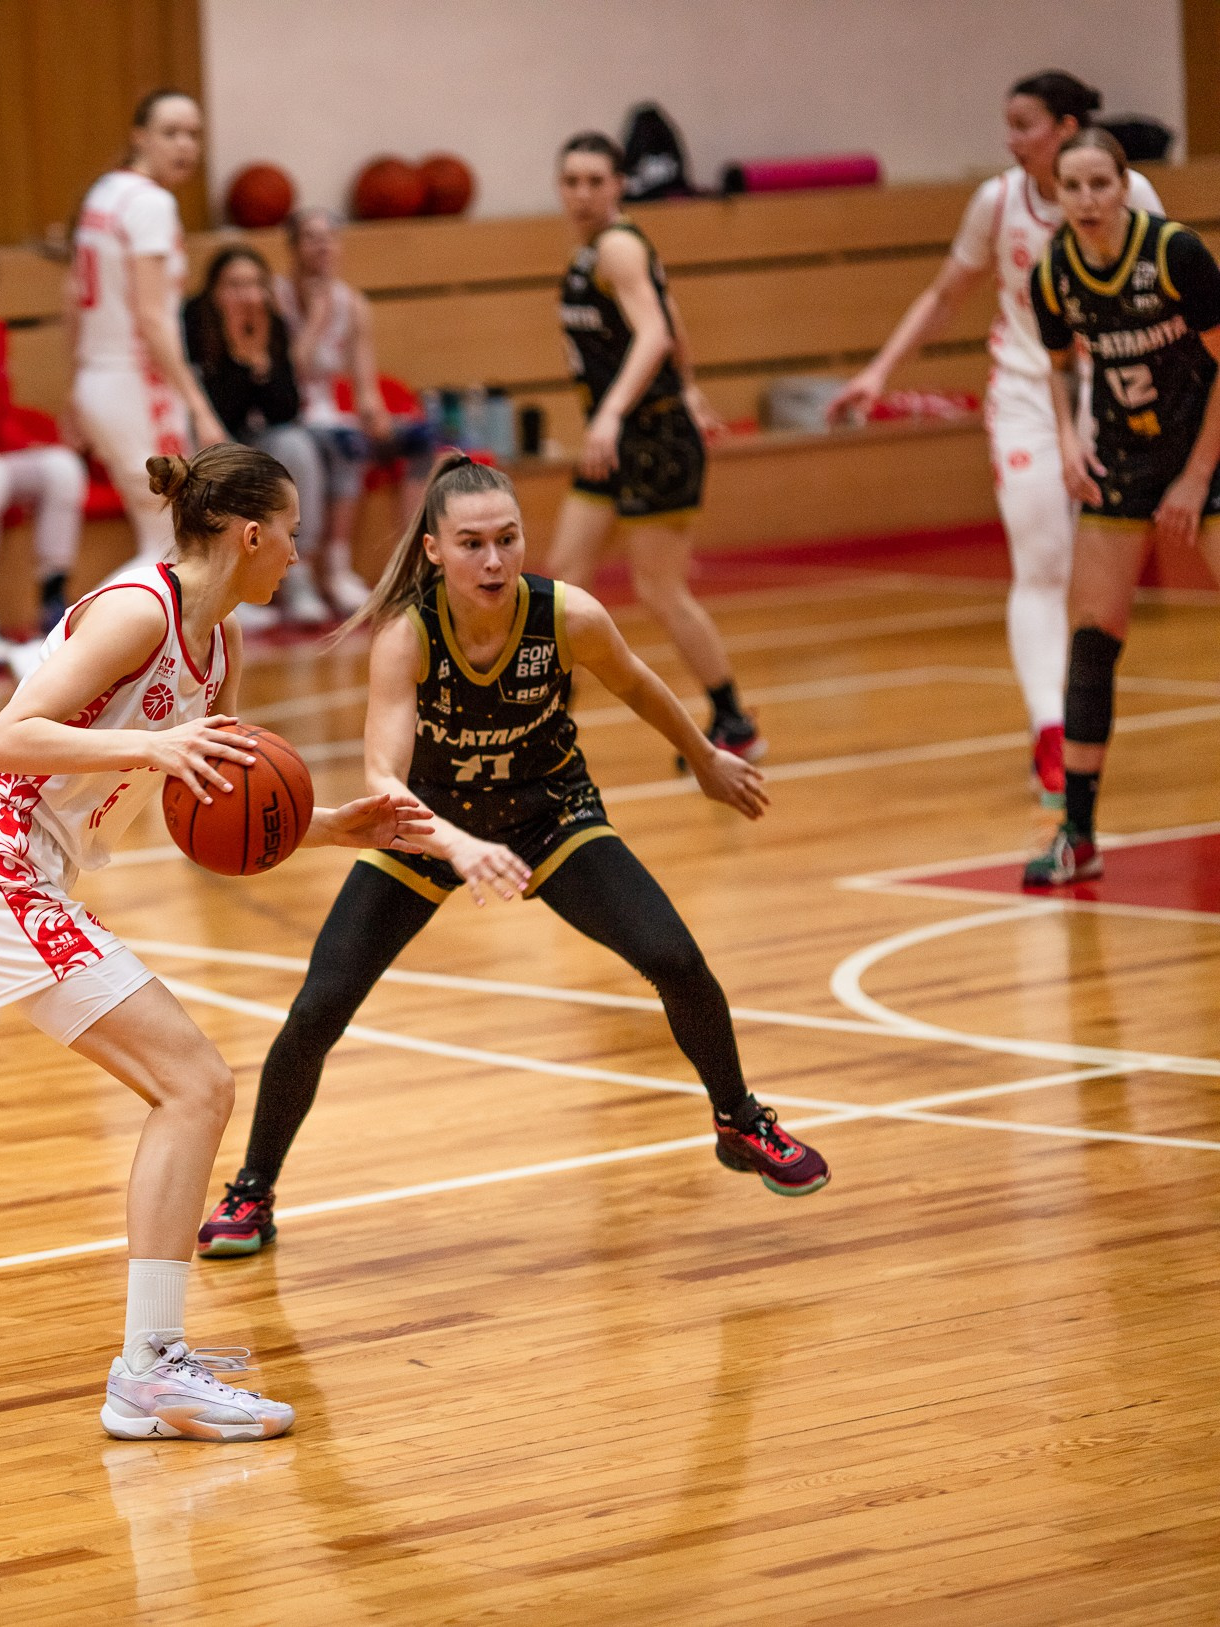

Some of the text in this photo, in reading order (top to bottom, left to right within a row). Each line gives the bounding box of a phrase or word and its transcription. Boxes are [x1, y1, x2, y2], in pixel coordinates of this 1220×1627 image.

[1104, 363, 1159, 409] 12
[519, 643, 555, 662] FON
[516, 658, 552, 678] BET
[50, 937, 79, 957] SPORT
